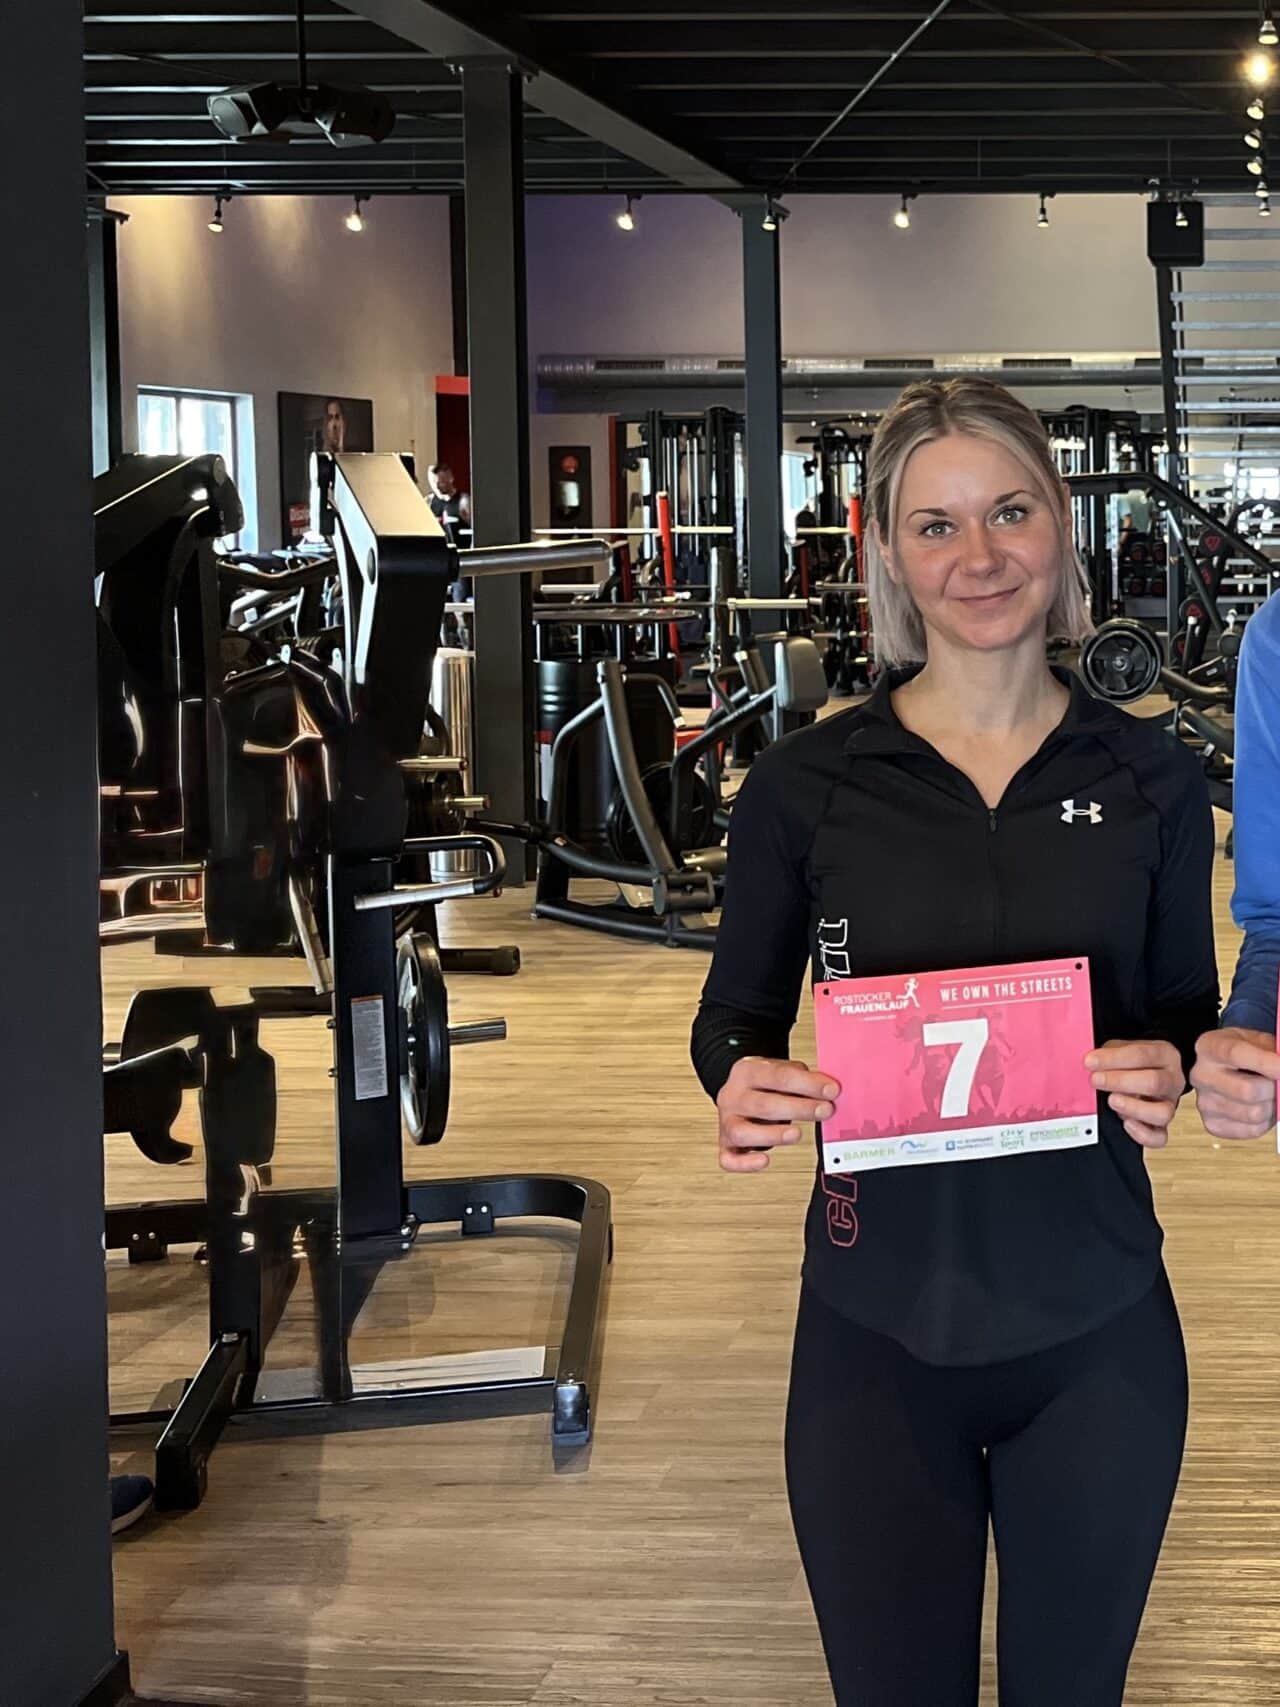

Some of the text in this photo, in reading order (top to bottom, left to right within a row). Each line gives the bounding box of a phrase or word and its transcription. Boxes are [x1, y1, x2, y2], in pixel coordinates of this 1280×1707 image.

[940, 976, 1073, 1002] WE OWN THE STREETS
[833, 991, 892, 1005] ROSTOCKER
[840, 1000, 909, 1015] FRAUENLAUF
[923, 1018, 989, 1119] 7
[843, 1147, 896, 1161] BARMER
